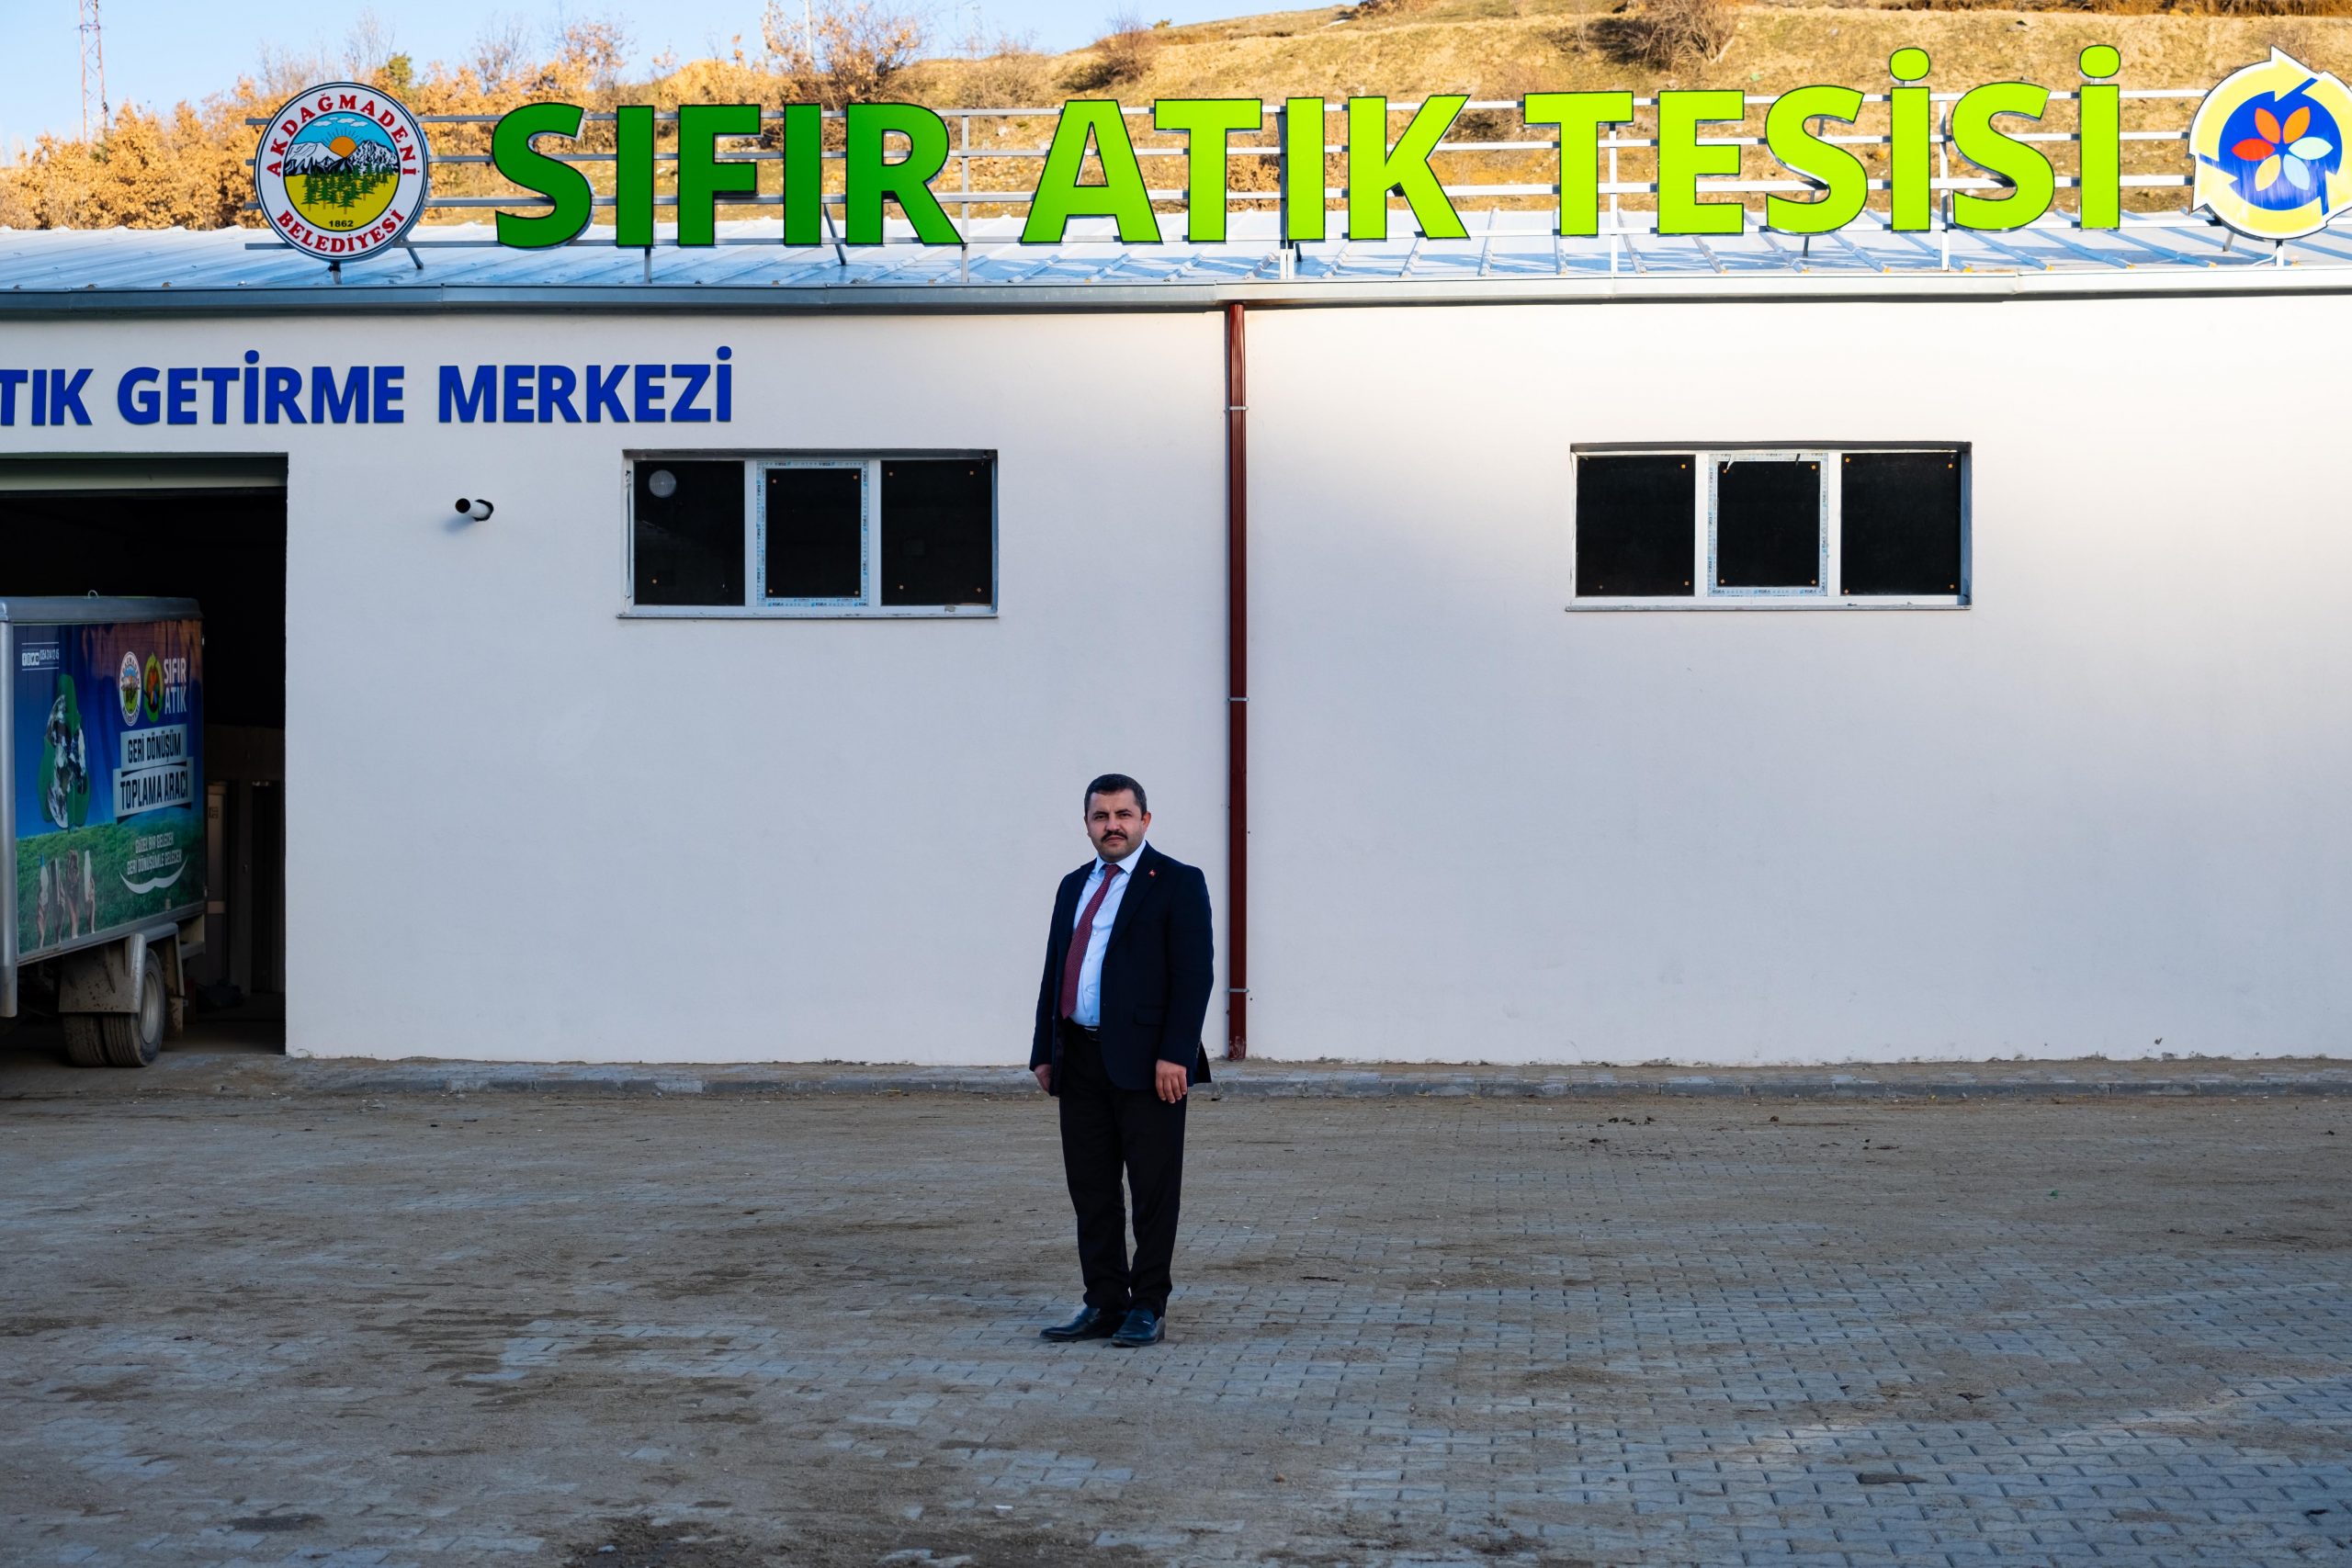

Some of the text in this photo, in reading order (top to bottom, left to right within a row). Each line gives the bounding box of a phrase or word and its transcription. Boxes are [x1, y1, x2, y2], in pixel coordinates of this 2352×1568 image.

[266, 93, 420, 177] AKDAĞMADENİ
[492, 44, 2120, 249] SIFIR ATIK TESİSİ
[277, 209, 405, 254] BELEDİYESİ
[328, 220, 354, 229] 1862
[117, 349, 405, 425] GETİRME
[438, 345, 733, 423] MERKEZİ
[164, 658, 187, 684] SIFIR
[164, 685, 187, 715] ATIK
[128, 728, 181, 763] GERİ DÖNÜŞÜM
[120, 770, 188, 810] TOPLAMA ARACI
